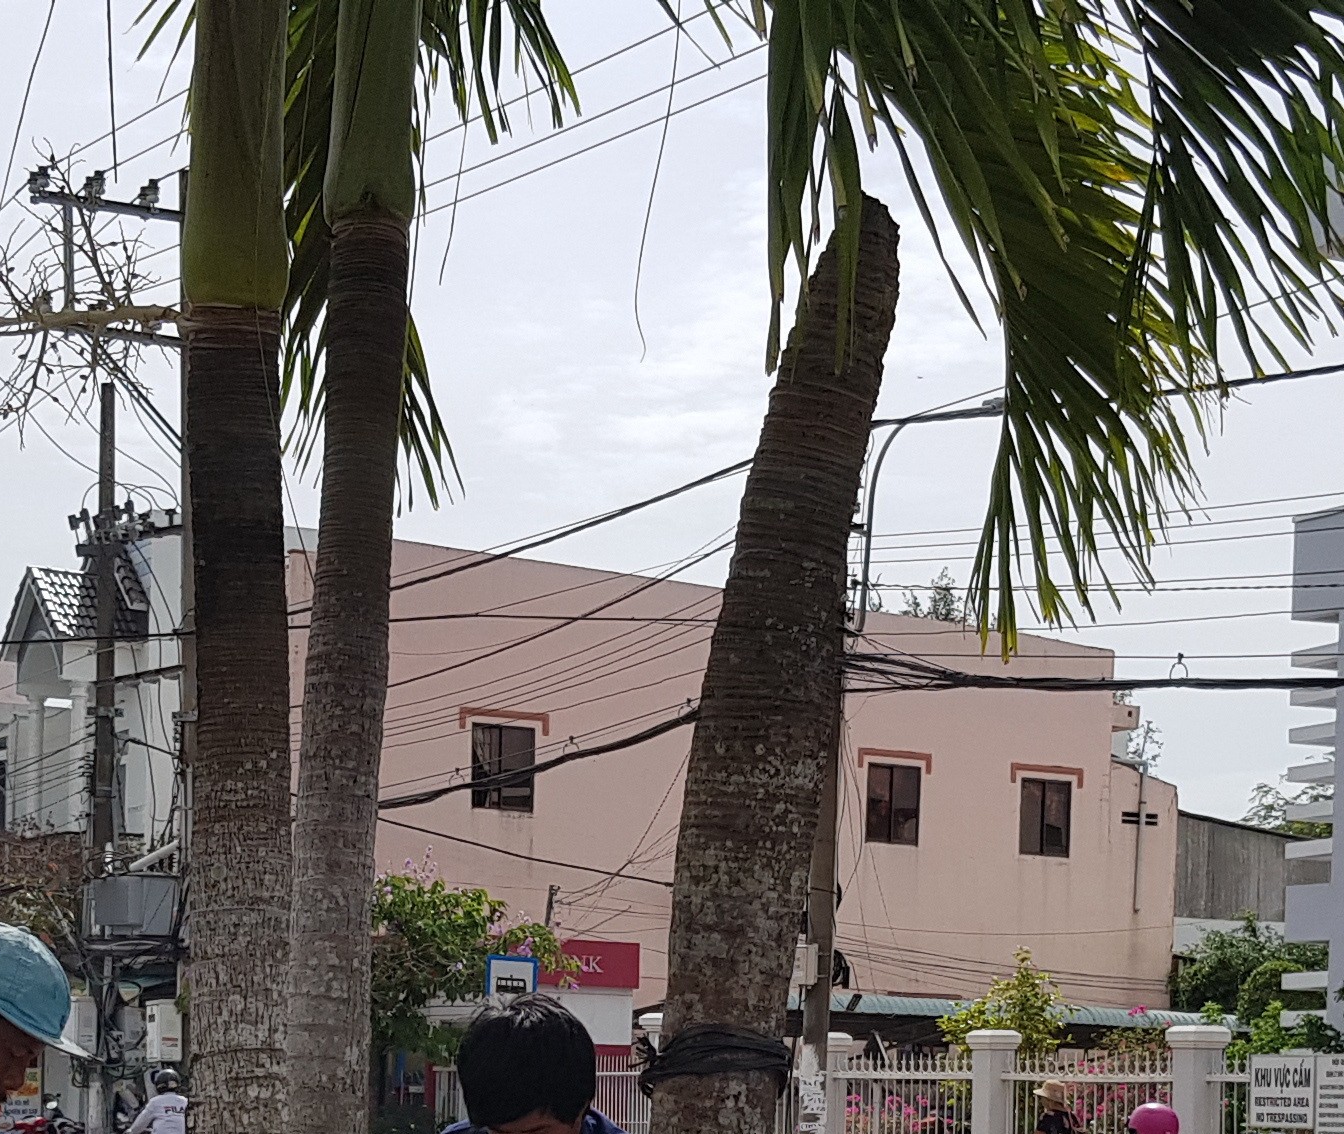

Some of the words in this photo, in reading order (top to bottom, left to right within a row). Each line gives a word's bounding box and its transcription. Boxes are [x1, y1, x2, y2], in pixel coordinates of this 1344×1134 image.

[1255, 1067, 1272, 1088] KHU
[1274, 1063, 1291, 1094] VỰC
[1293, 1058, 1311, 1088] CẤM
[1254, 1096, 1291, 1107] RESTRICTED
[1293, 1097, 1309, 1108] AREA
[1256, 1112, 1265, 1123] NO
[1266, 1112, 1308, 1123] TRESPASSING
